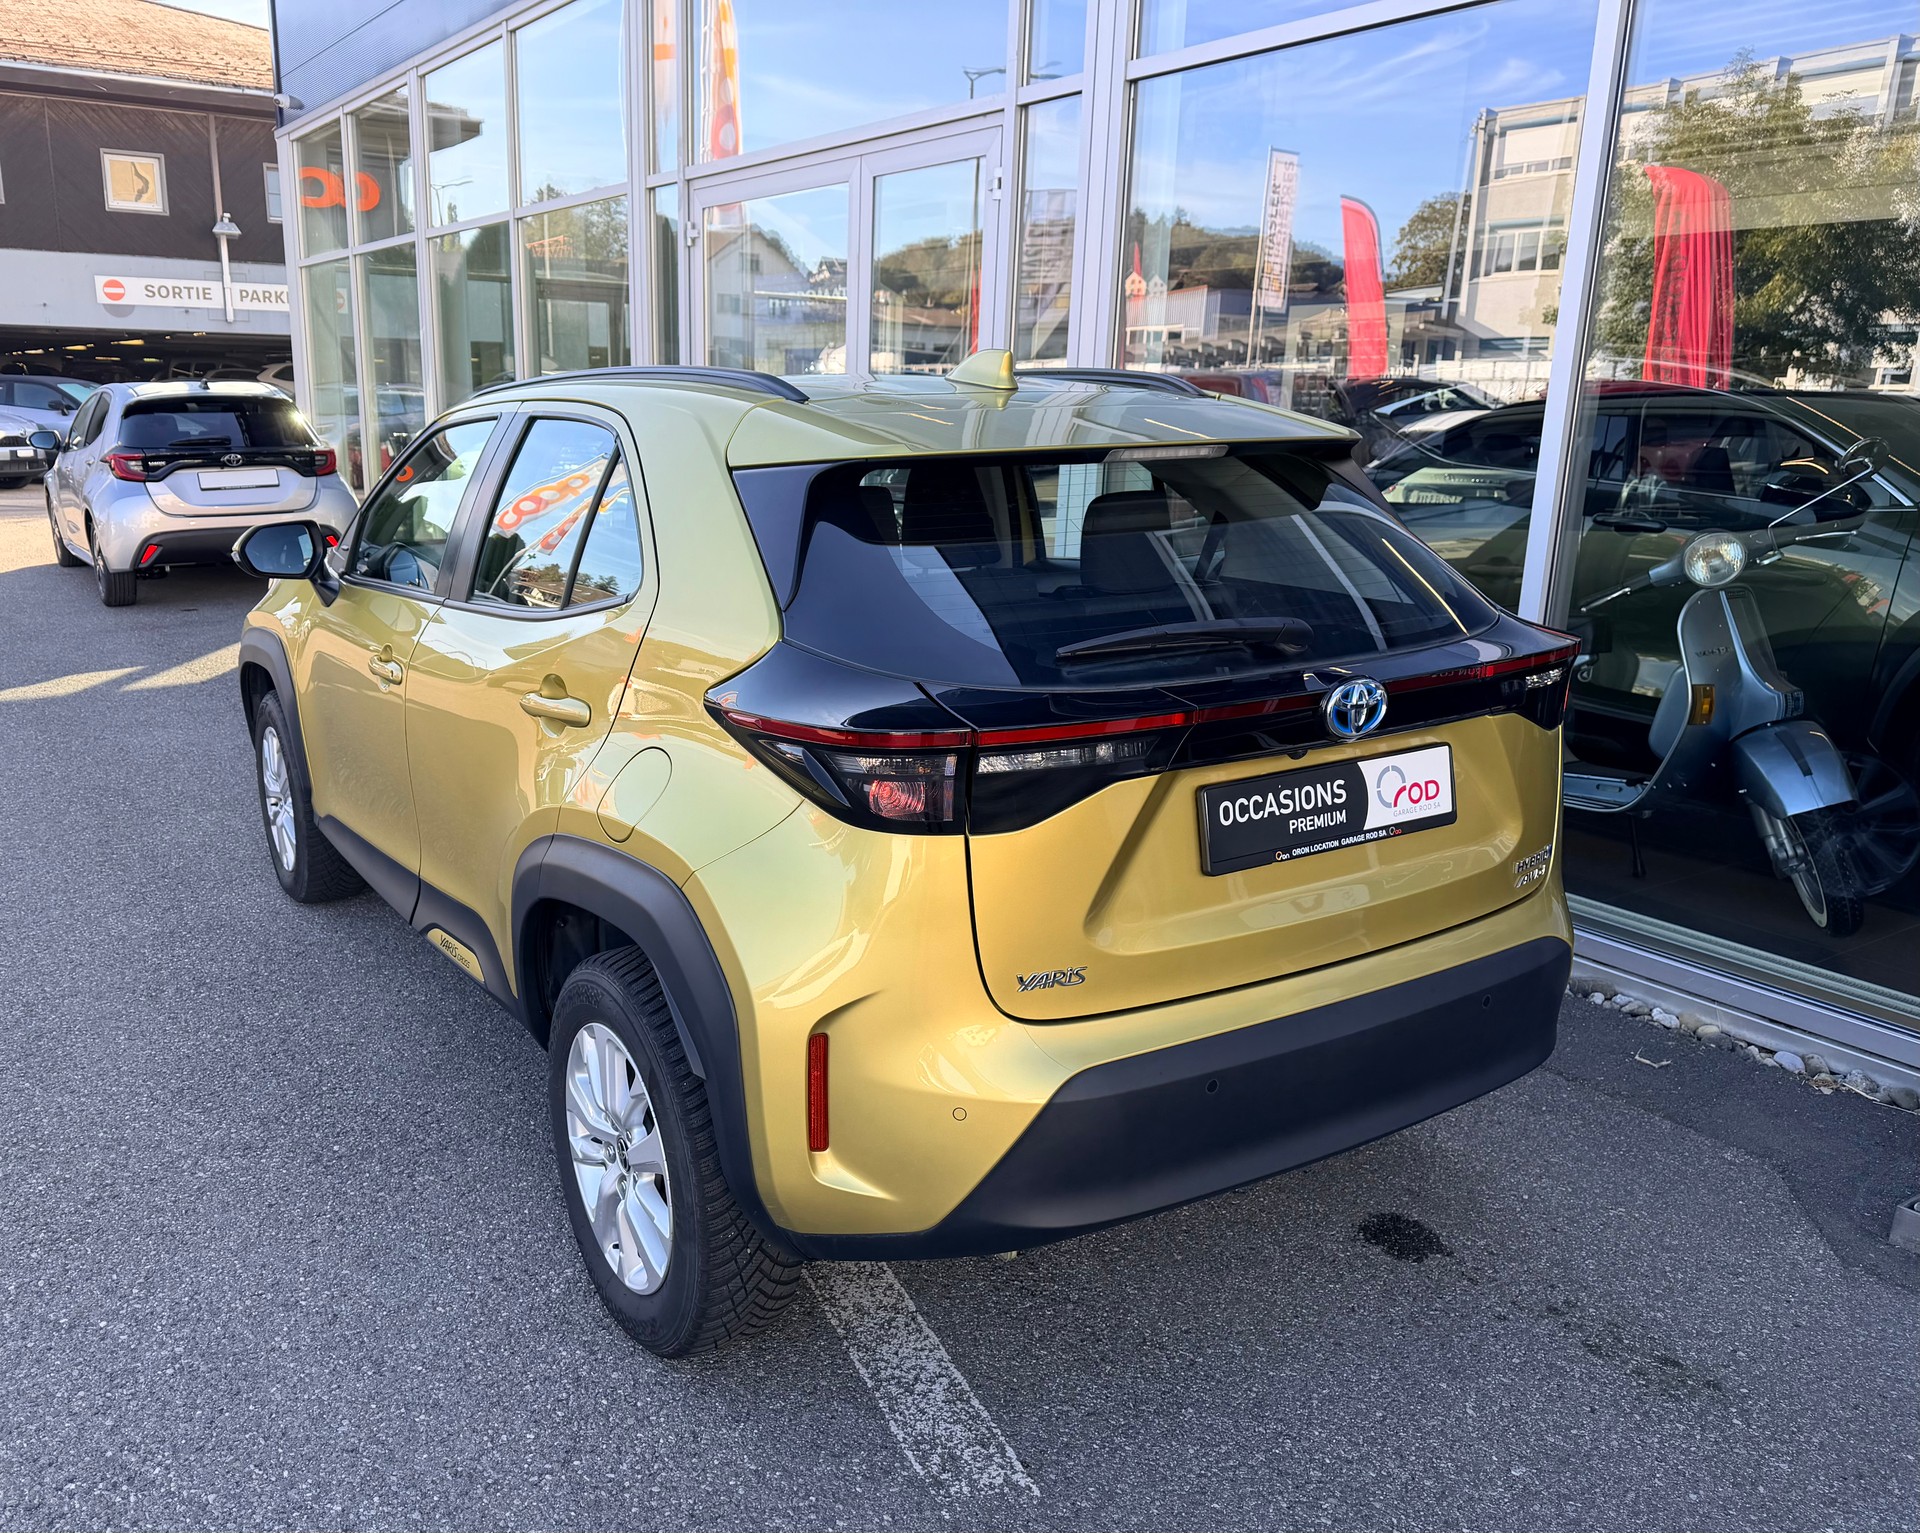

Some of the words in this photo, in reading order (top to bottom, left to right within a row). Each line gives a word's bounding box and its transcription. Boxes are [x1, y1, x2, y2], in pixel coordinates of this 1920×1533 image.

[144, 284, 213, 301] SORTIE
[1218, 779, 1347, 826] OCCASIONS
[1393, 806, 1418, 817] GARAGE
[1419, 803, 1432, 812] ROD
[1433, 801, 1441, 809] SA
[1289, 809, 1347, 834] PREMIUM
[1292, 847, 1310, 856] ORON
[1310, 840, 1339, 853] LOCATION
[1341, 833, 1366, 846] GARAGE
[1366, 831, 1378, 840] ROD
[1514, 848, 1551, 873] HYBRID
